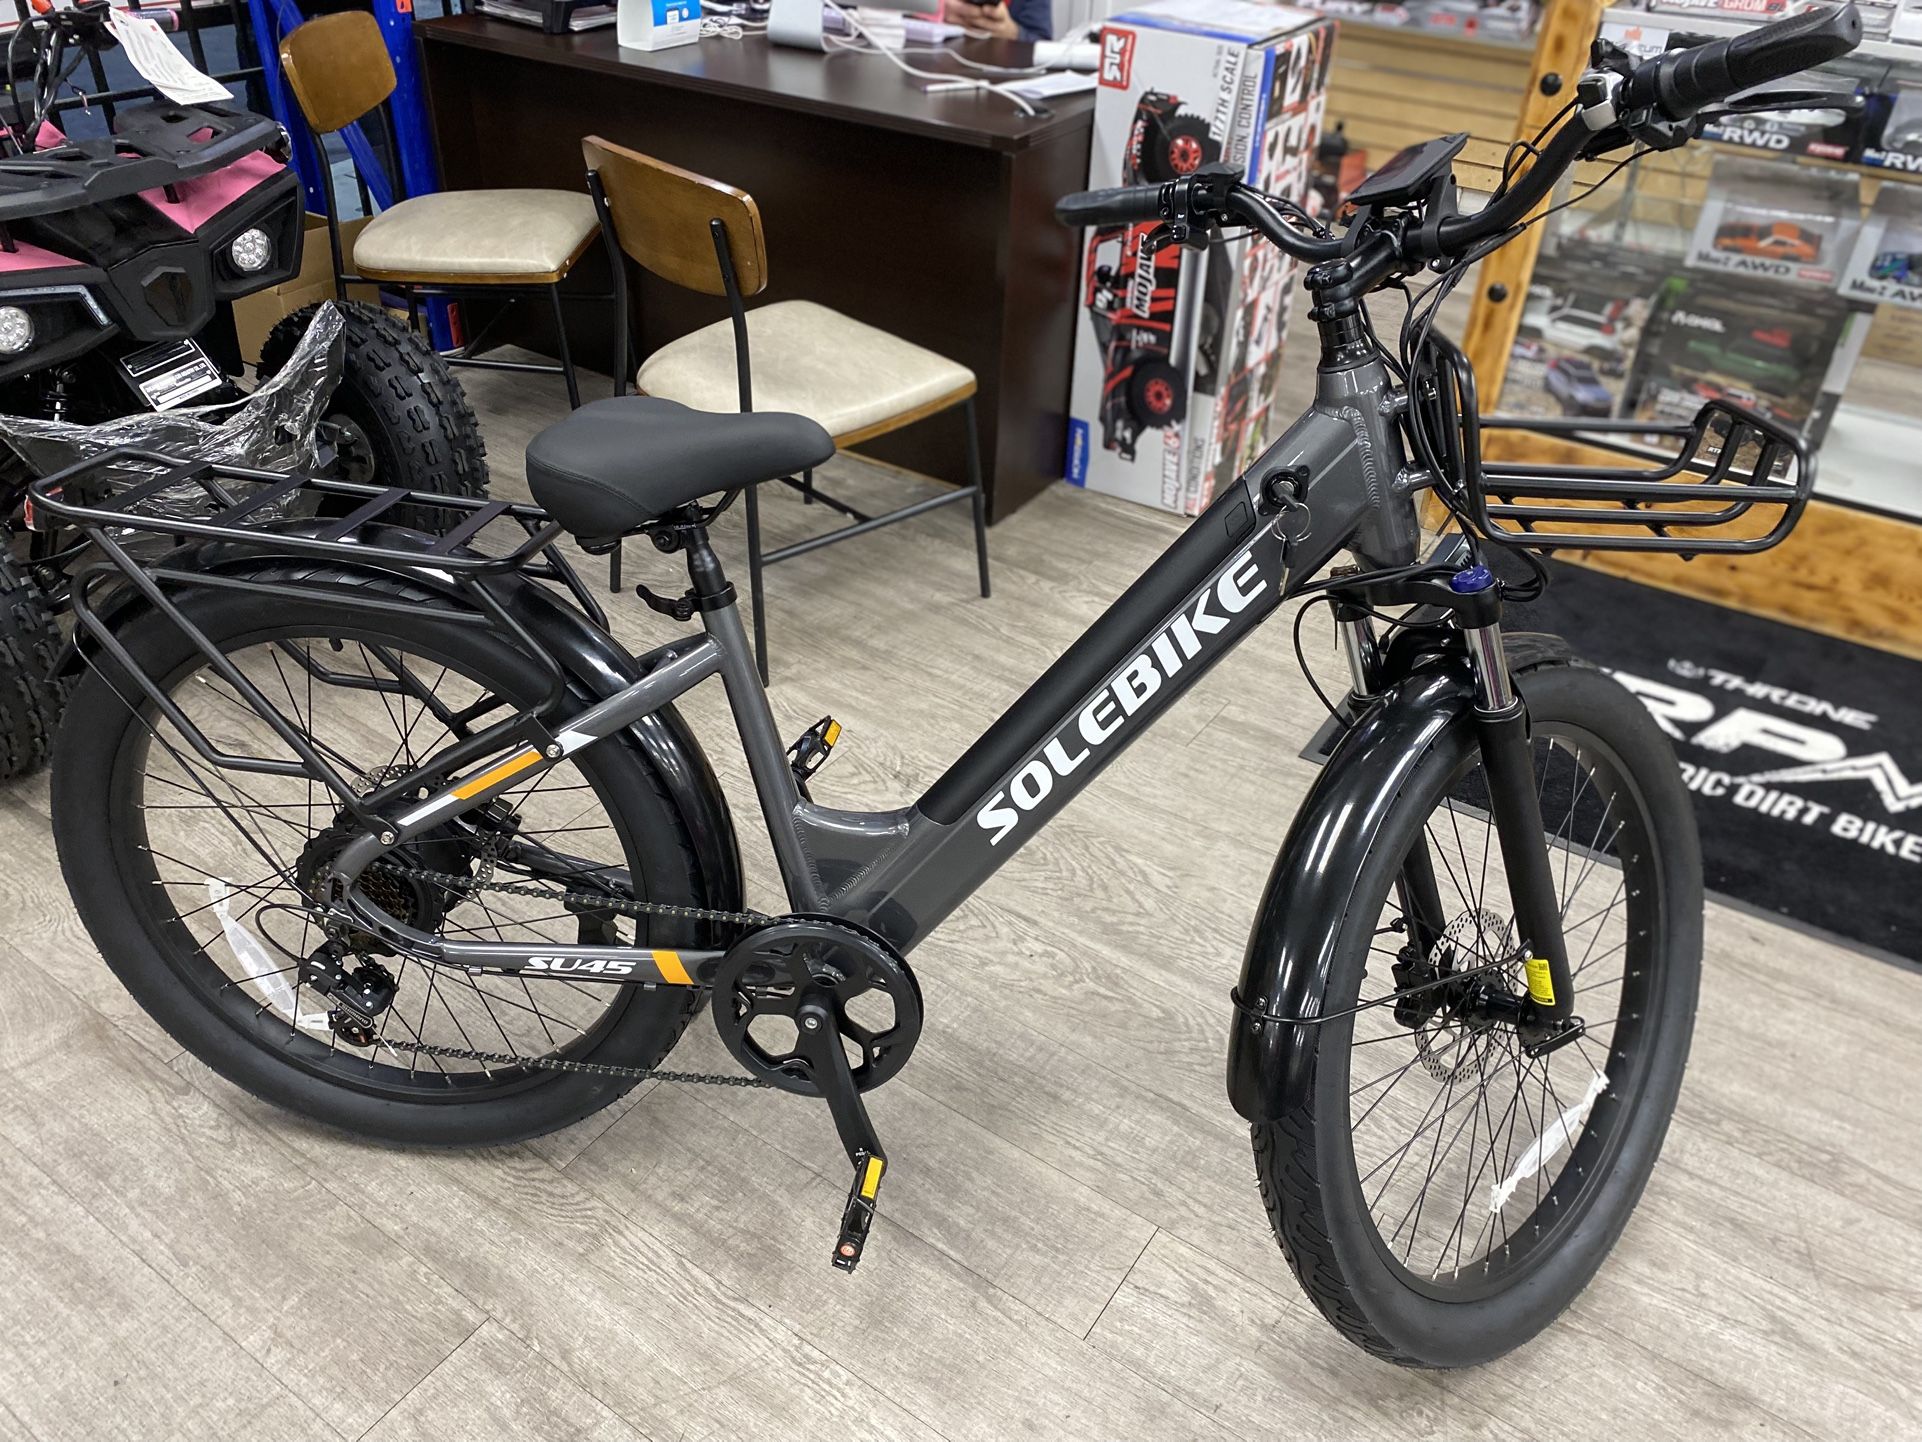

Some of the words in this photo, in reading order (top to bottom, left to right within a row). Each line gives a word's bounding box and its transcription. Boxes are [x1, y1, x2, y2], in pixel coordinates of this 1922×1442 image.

[1212, 101, 1229, 139] 1/7TH
[1225, 48, 1240, 95] SCALE
[1241, 73, 1258, 129] CONTROL
[1722, 126, 1790, 149] RWD
[1735, 259, 1791, 276] AWD
[1162, 449, 1182, 510] MOJAVE
[976, 550, 1268, 847] SOLEBIKE
[1707, 669, 1879, 731] THRONE
[1732, 783, 1831, 826] DIRT
[525, 956, 637, 975] SU45
